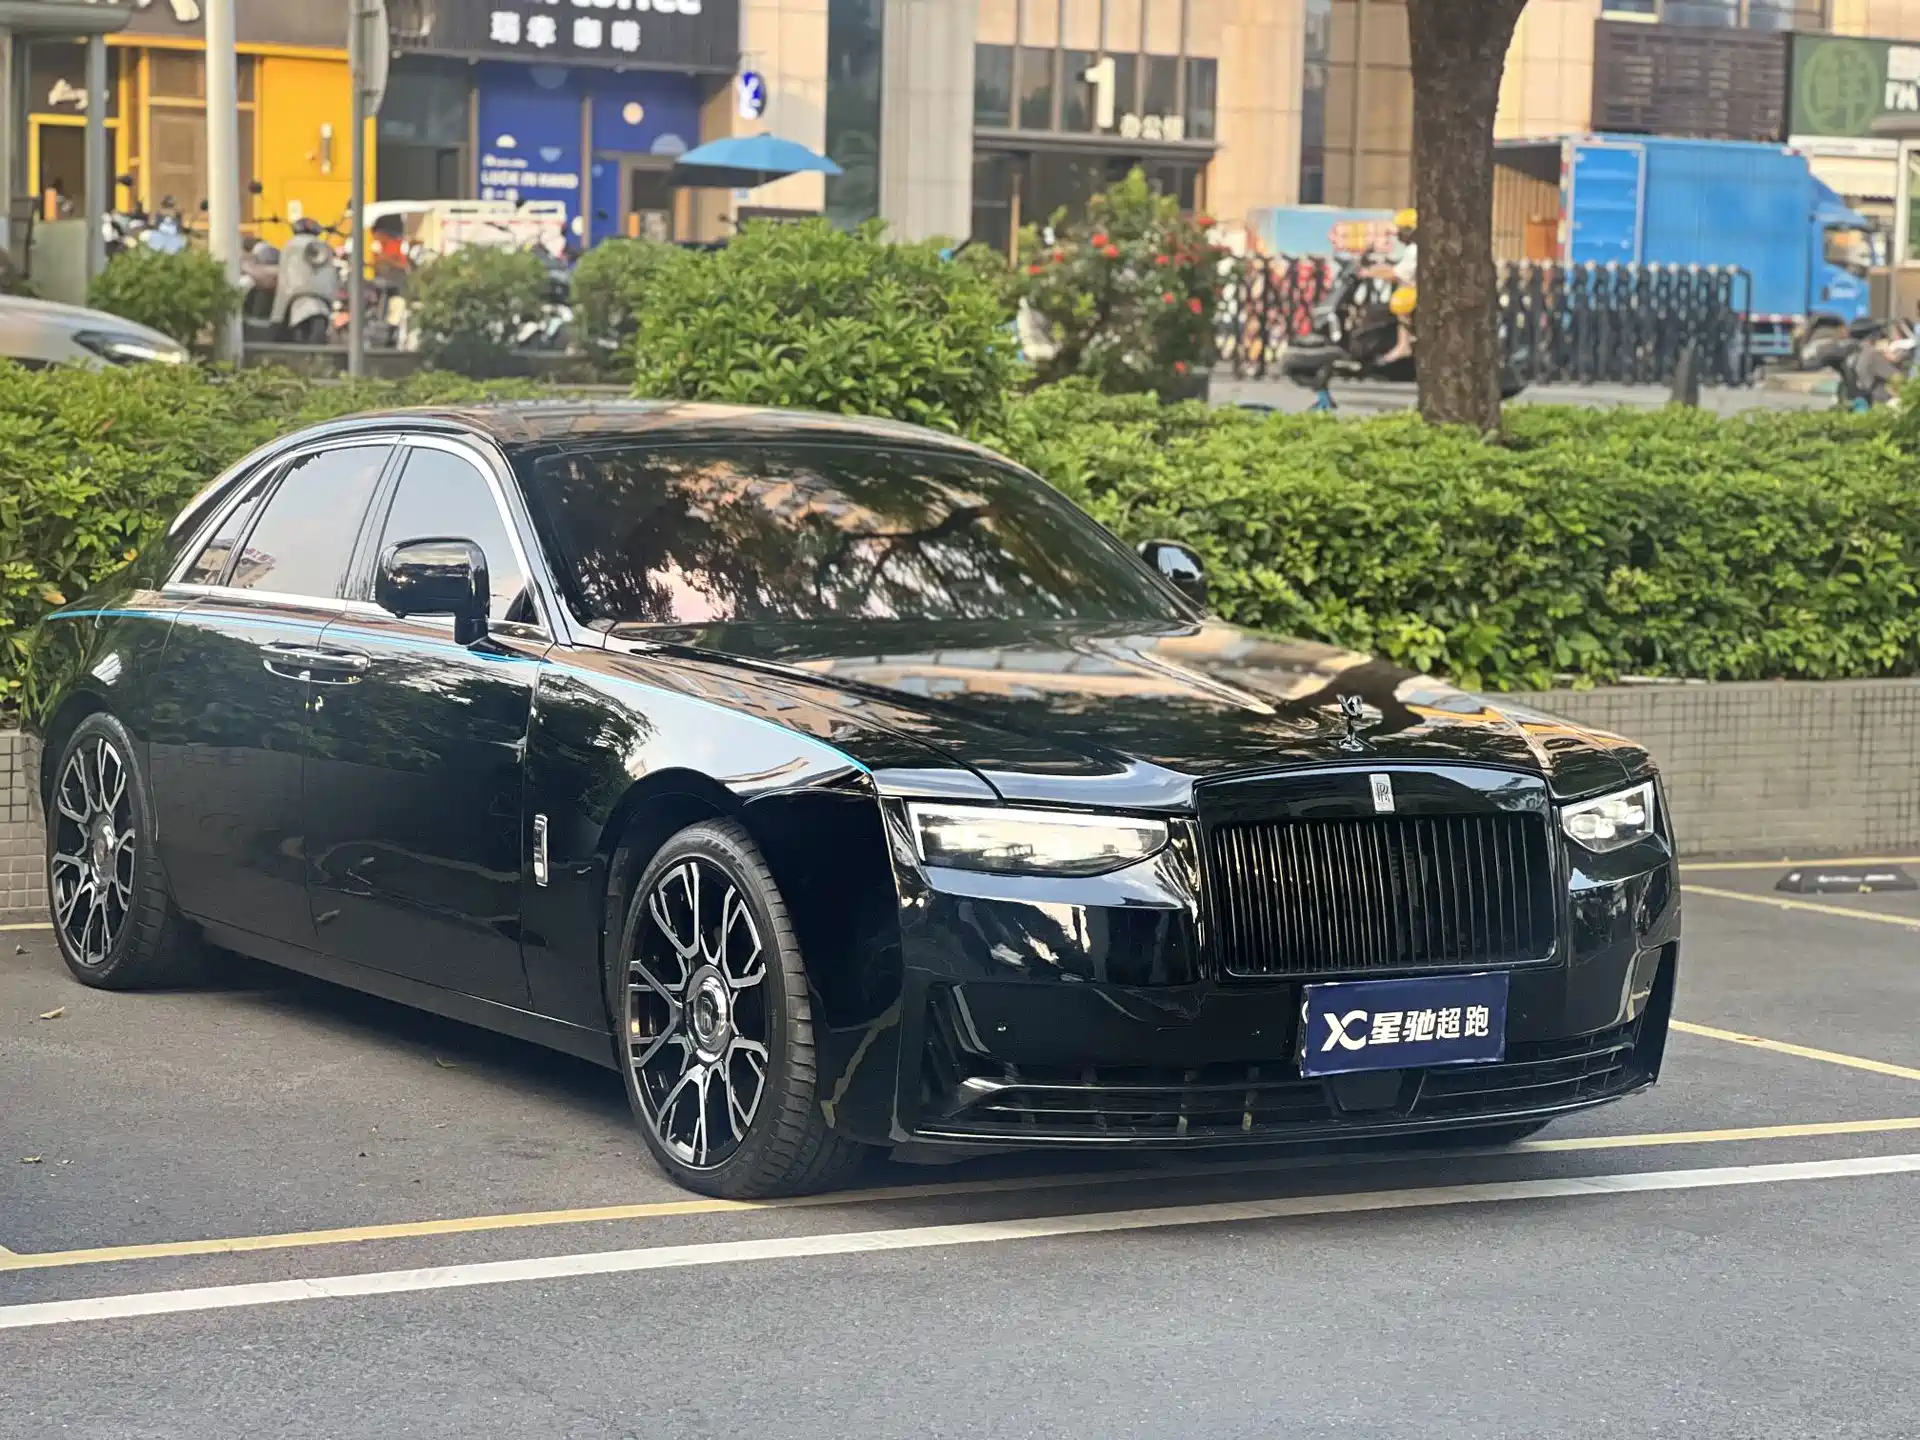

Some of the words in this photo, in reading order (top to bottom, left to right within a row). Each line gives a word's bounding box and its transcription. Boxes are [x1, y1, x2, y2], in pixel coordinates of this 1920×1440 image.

[1084, 56, 1116, 128] 1
[1368, 1004, 1489, 1045] 星驰超跑
